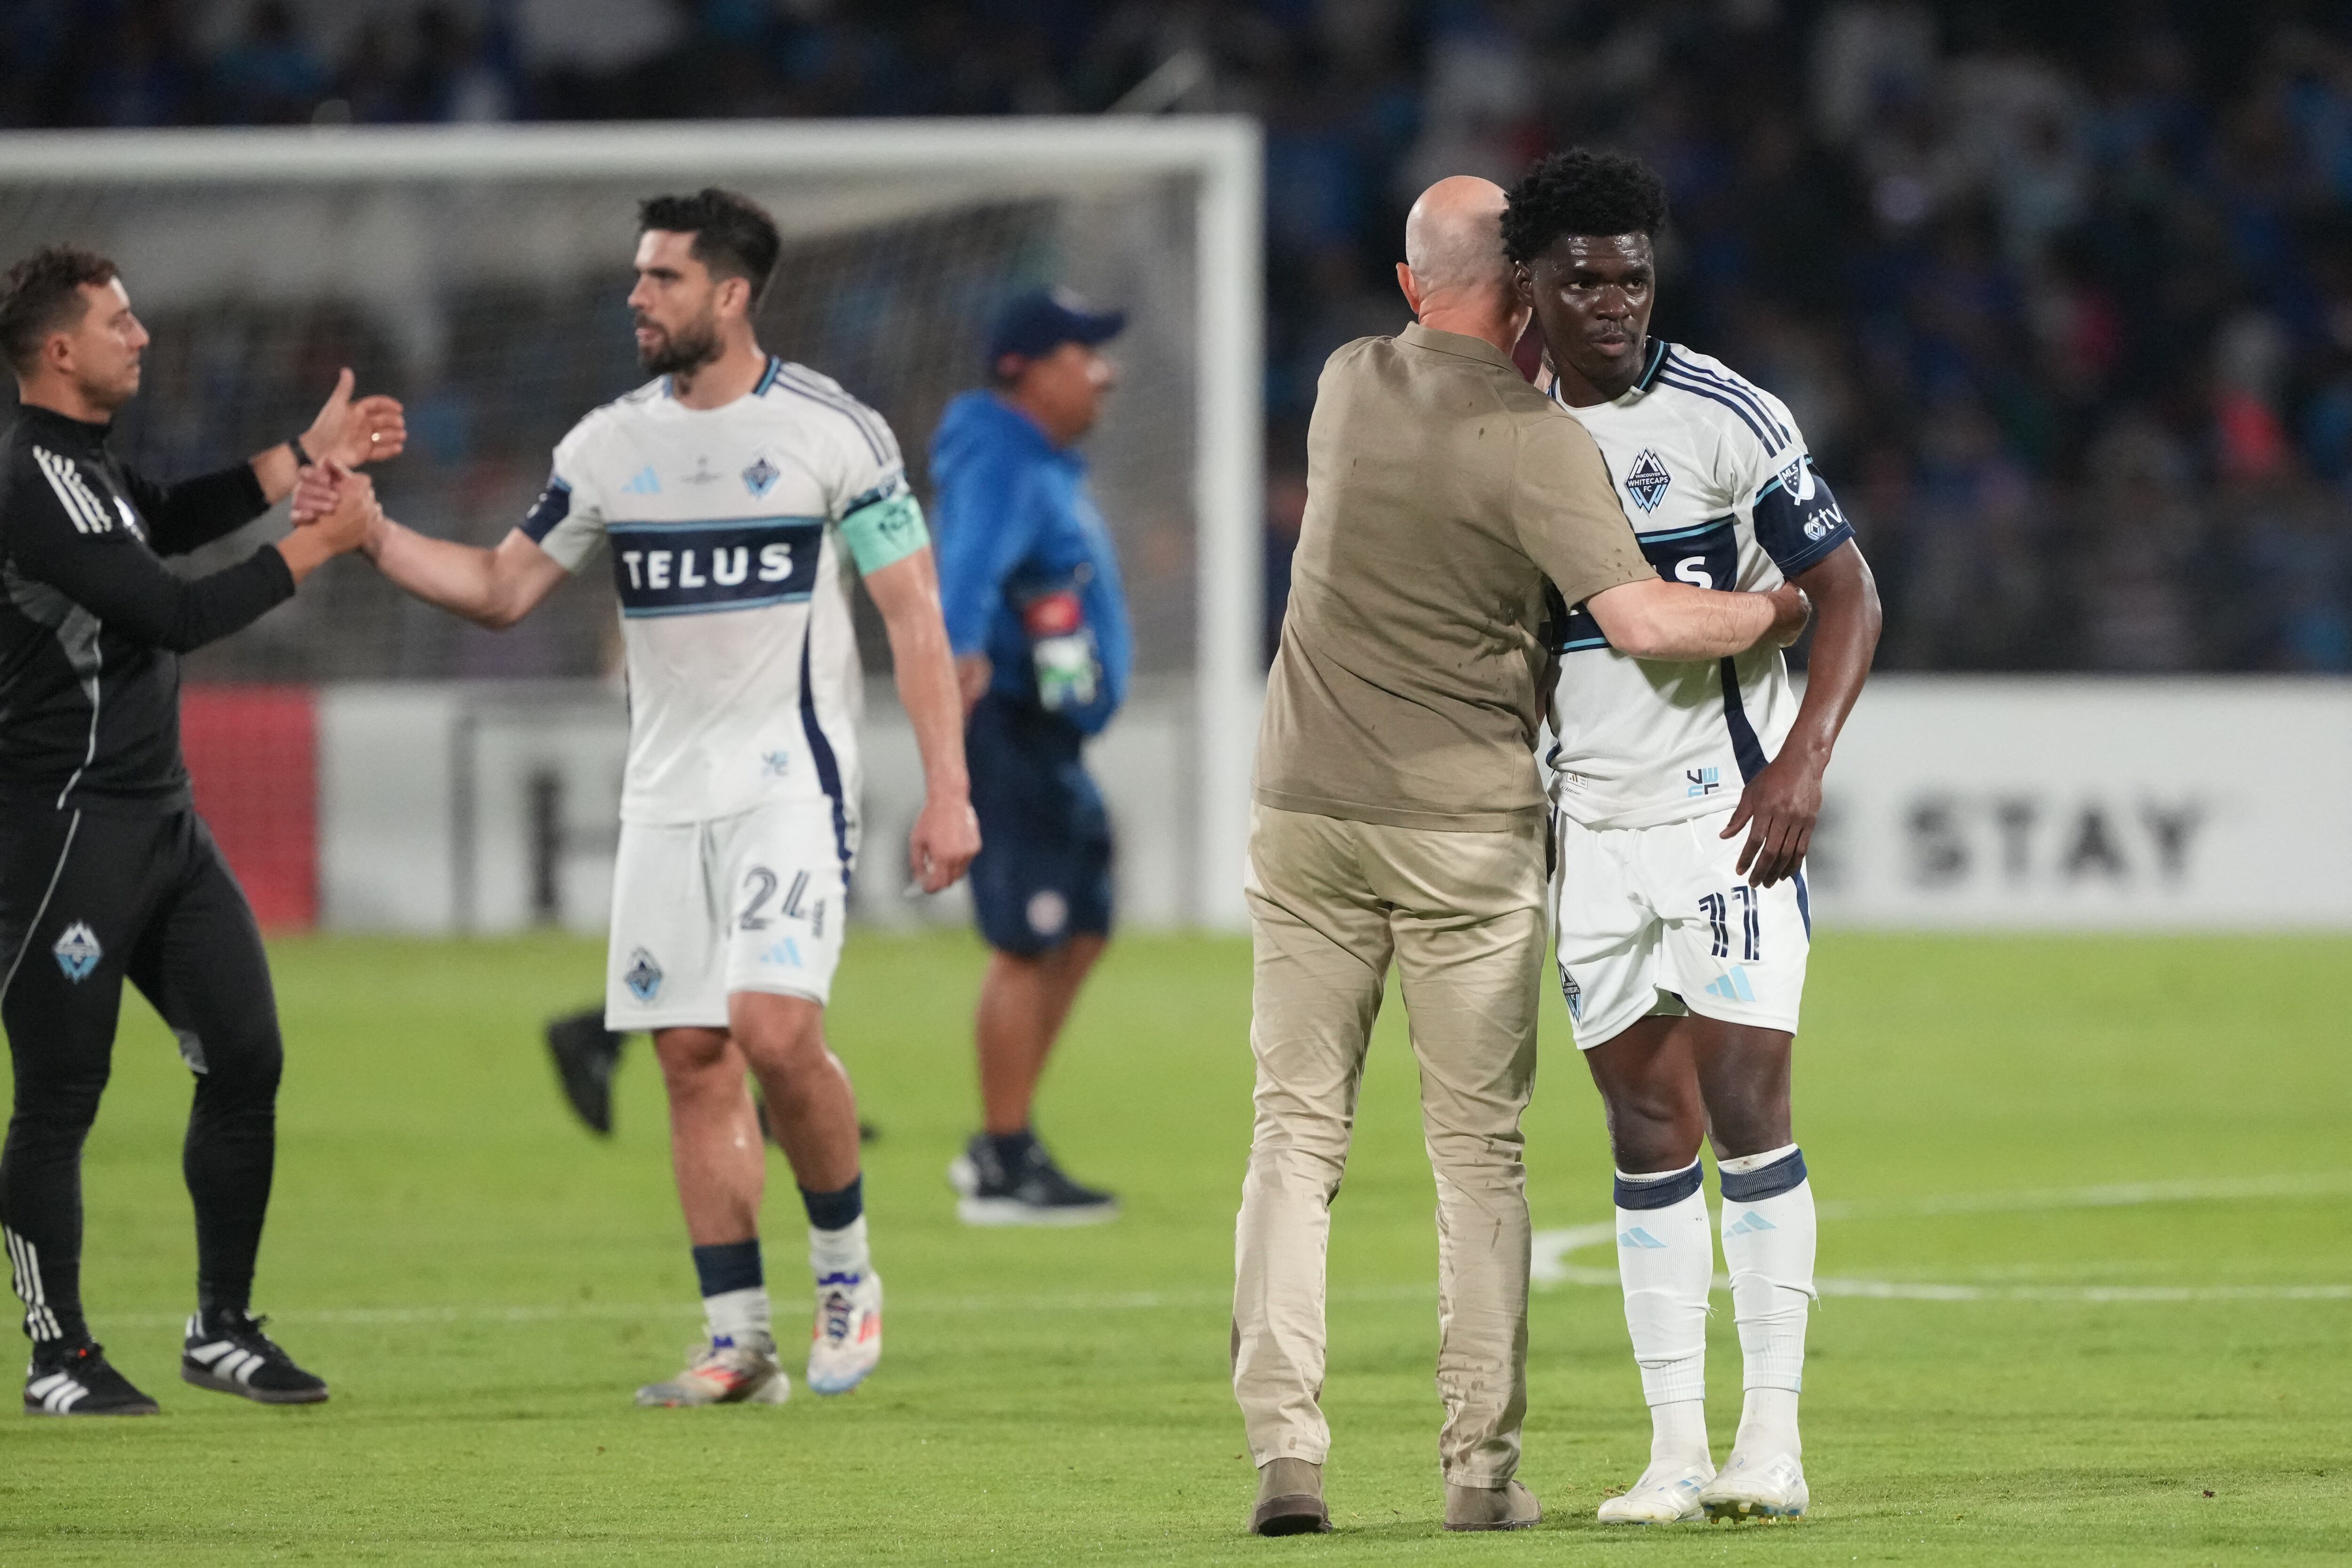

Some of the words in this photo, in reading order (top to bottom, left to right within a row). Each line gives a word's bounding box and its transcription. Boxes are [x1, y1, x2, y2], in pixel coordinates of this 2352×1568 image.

[1628, 476, 1669, 487] WHITECAPS
[1781, 464, 1799, 480] MLS
[1819, 503, 1843, 529] tv
[622, 543, 793, 590] TELUS
[1901, 791, 2207, 889] STAY
[740, 867, 825, 939] 24
[1699, 885, 1760, 961] 11
